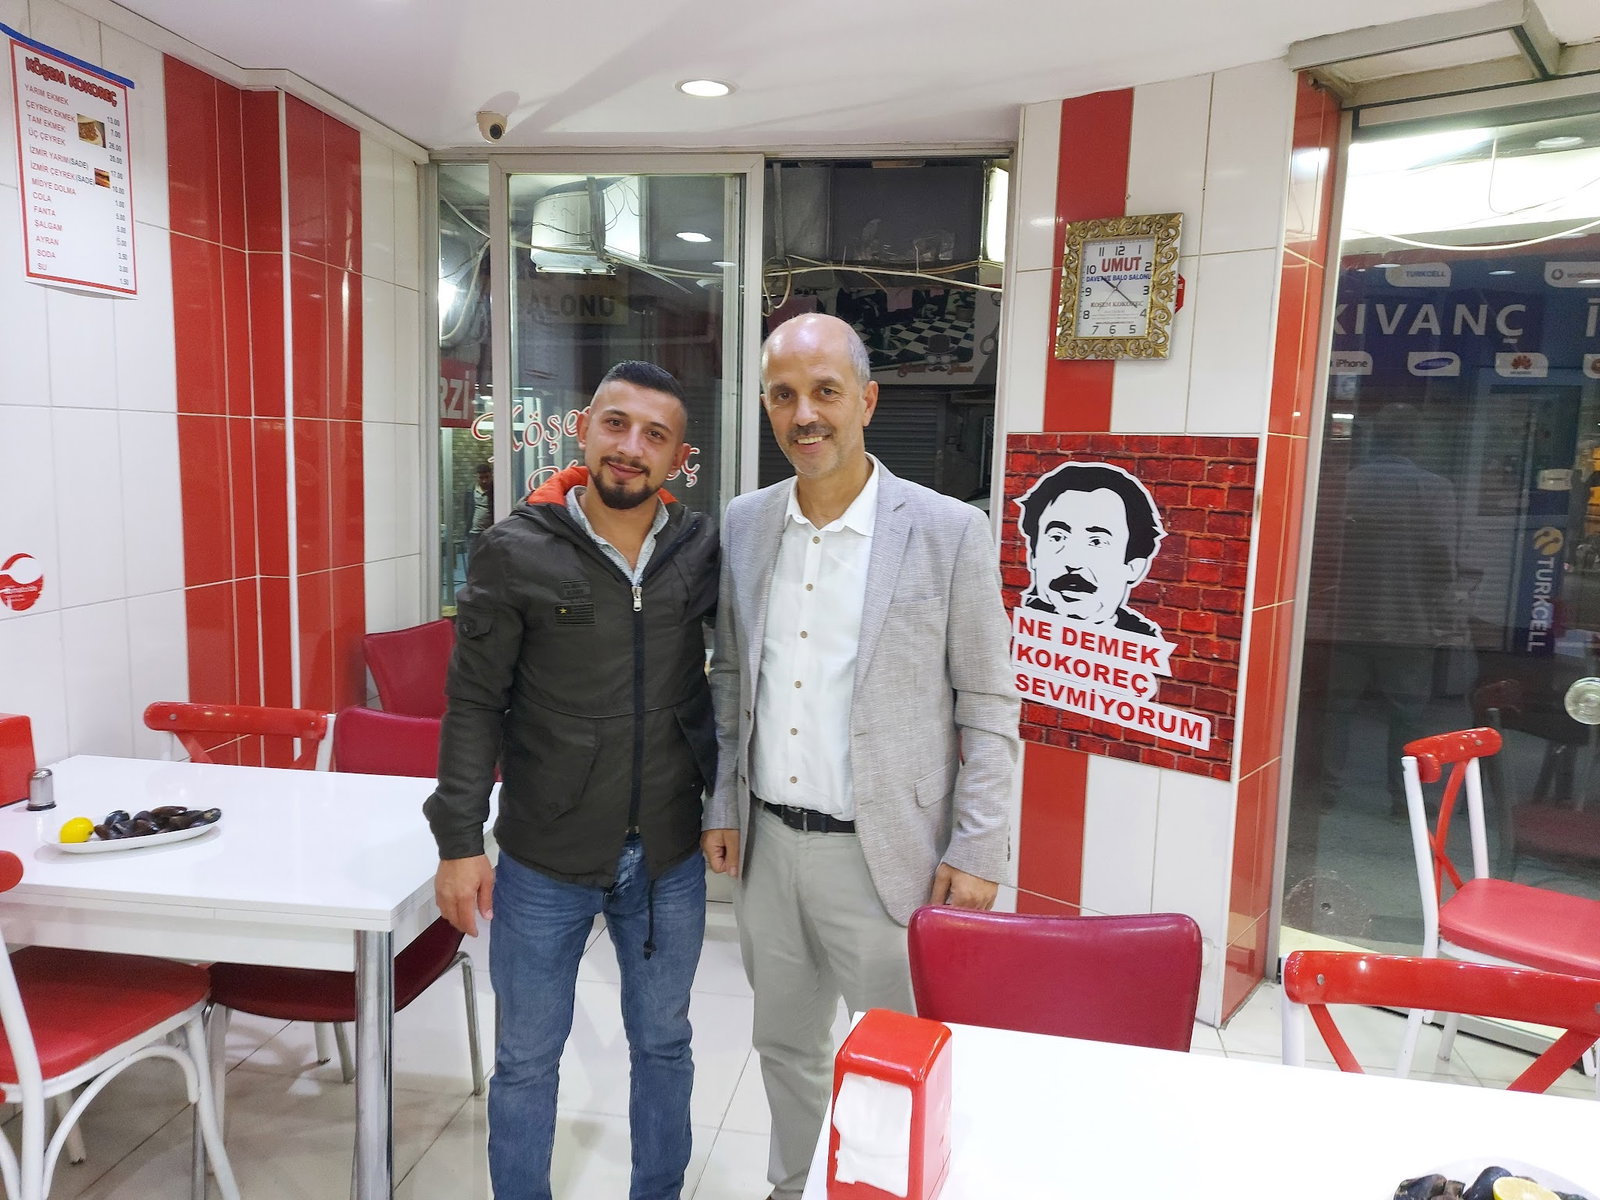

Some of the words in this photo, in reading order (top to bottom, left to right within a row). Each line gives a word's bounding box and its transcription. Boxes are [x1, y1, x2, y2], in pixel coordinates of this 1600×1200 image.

[25, 56, 66, 85] KÖŞEM
[68, 74, 117, 107] KOKOREÇ
[25, 84, 45, 98] YARIM
[47, 92, 69, 106] EKMEK
[26, 100, 53, 115] ÇEYREK
[54, 110, 76, 122] EKMEK
[27, 114, 42, 126] TAM
[44, 120, 66, 132] EKMEK
[40, 132, 66, 146] ÇEYREK
[54, 184, 76, 196] DOLMA
[32, 192, 52, 202] COLA
[34, 206, 56, 217] FANTA
[36, 236, 60, 246] AYRAN
[37, 248, 56, 258] SODA
[1098, 247, 1104, 256] 11
[1115, 246, 1126, 256] 12
[38, 263, 48, 271] SU
[1101, 256, 1142, 272] UMUT
[1144, 262, 1152, 272] 2
[1086, 265, 1096, 274] 10
[1084, 287, 1092, 296] 9
[1143, 286, 1150, 296] 3
[1082, 310, 1090, 320] 8
[1140, 308, 1148, 318] 4
[1092, 325, 1099, 334] 7
[1109, 324, 1116, 334] 6
[1128, 324, 1136, 334] 5
[1334, 304, 1526, 344] KIVANÇ
[1335, 358, 1368, 368] iPhone
[1527, 557, 1556, 652] TURKCELL
[1018, 616, 1052, 642] NE
[1062, 626, 1162, 668] DEMEK
[1016, 644, 1150, 698] KOKOREÇ
[1014, 672, 1203, 742] SEVMİYORUM
